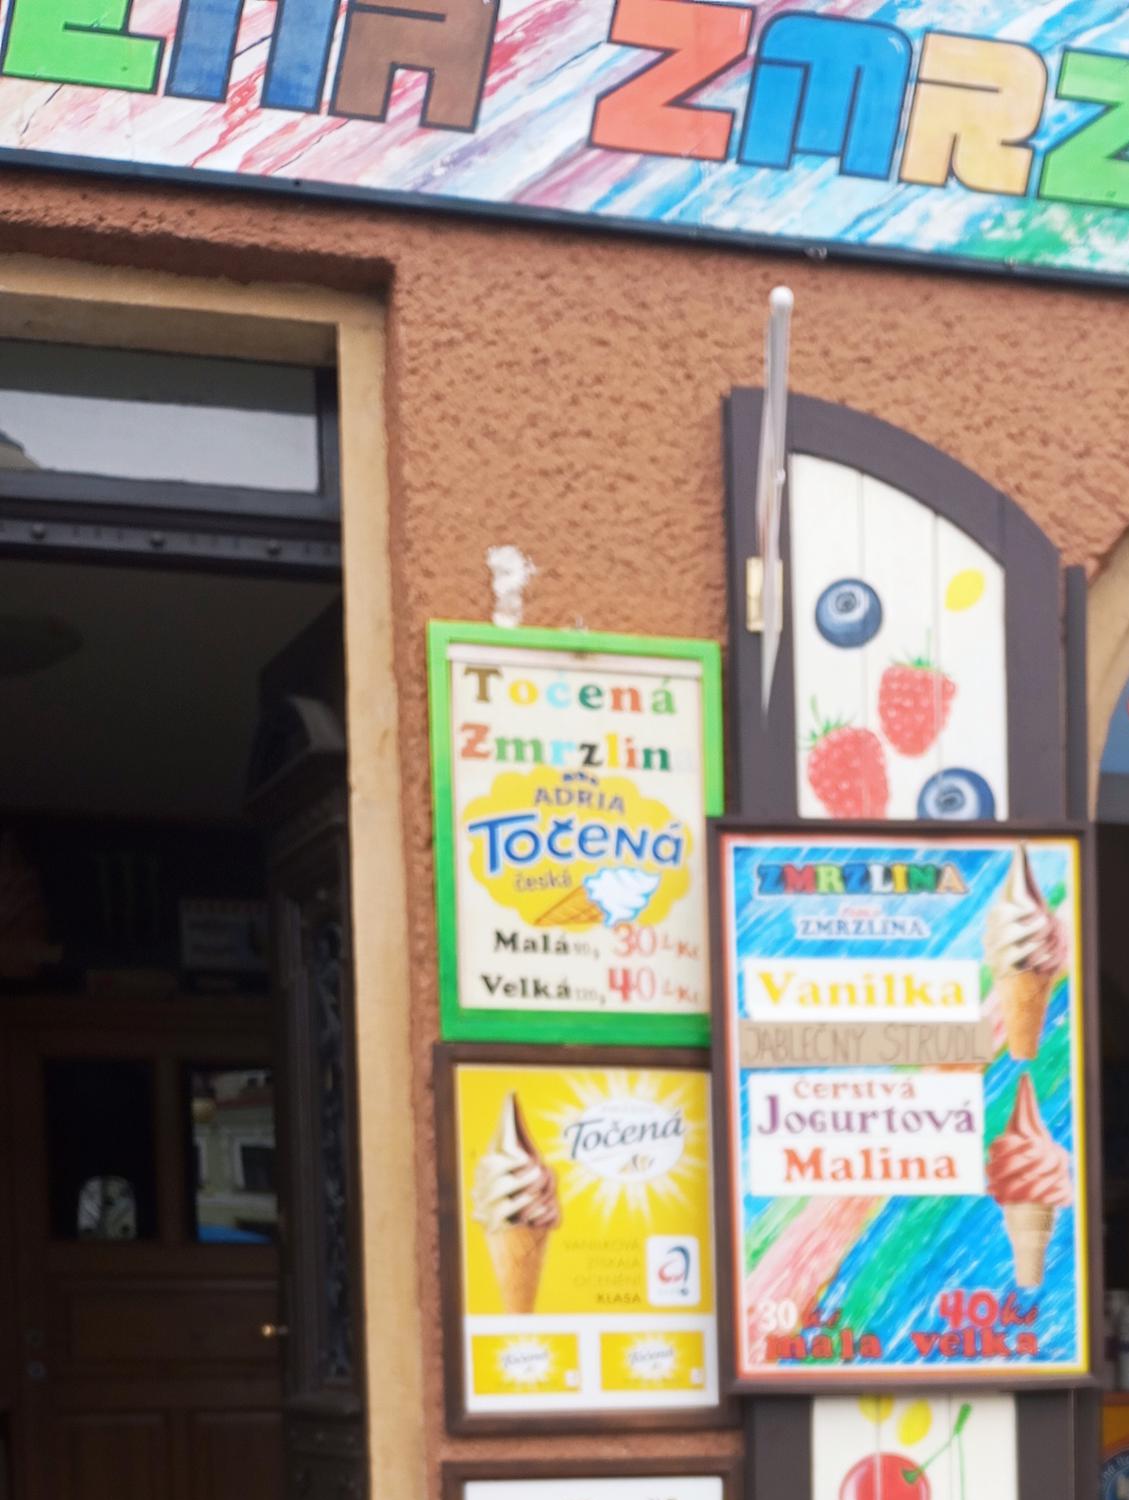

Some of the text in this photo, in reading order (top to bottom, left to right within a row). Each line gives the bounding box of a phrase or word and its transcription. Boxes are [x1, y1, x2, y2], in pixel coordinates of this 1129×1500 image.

[463, 666, 677, 715] Točená
[459, 722, 697, 772] Zmrzlin
[533, 787, 625, 814] ADRIA
[467, 813, 684, 874] Točená
[757, 863, 969, 895] ZMRZLINA
[493, 930, 569, 955] Malá
[481, 974, 571, 999] Velká
[758, 972, 968, 1007] Vanilka
[564, 1107, 685, 1159] Točená
[783, 1147, 959, 1183] Malina
[758, 1300, 797, 1331] 30
[940, 1289, 998, 1329] 40
